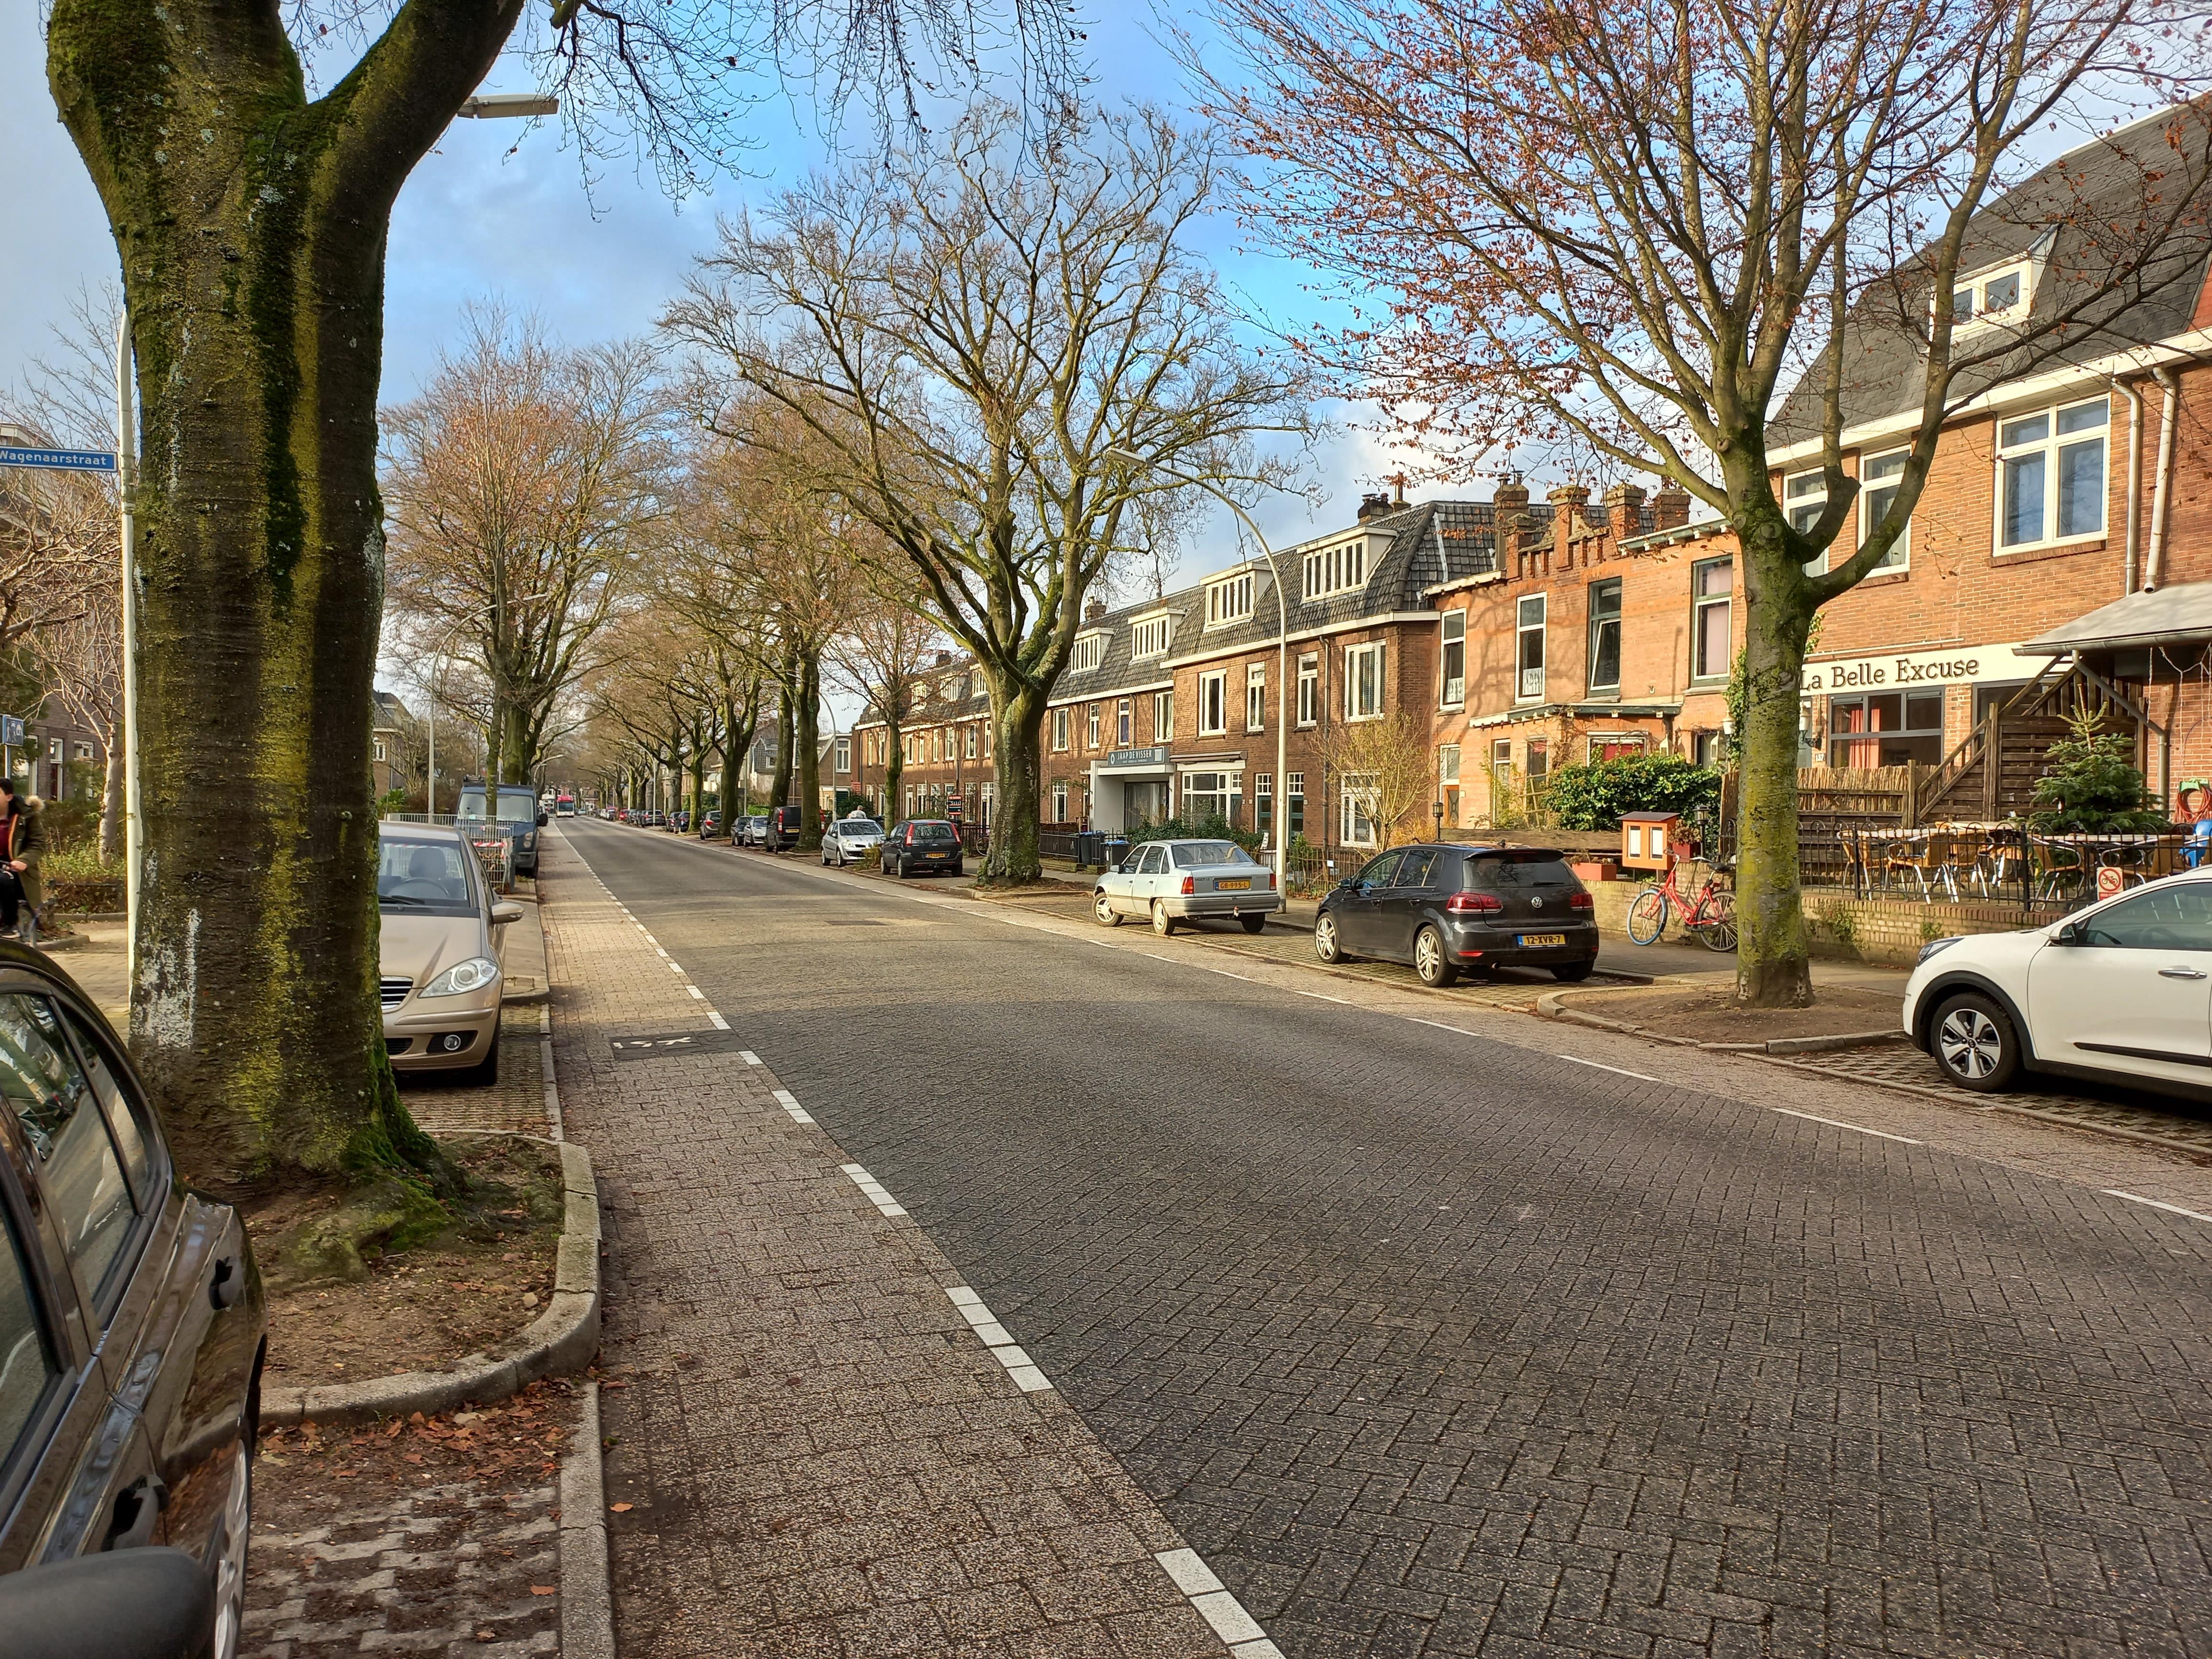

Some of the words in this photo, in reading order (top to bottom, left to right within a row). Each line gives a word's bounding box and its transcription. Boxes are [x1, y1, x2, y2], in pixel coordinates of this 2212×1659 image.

[0, 450, 106, 465] Wagenaarstraat
[1831, 663, 1885, 688] Belle
[1895, 658, 1980, 683] Excuse
[1117, 752, 1128, 760] JAAP
[1129, 751, 1135, 759] DE
[1135, 750, 1152, 759] VISSER
[1526, 935, 1561, 945] 12-XVR-7
